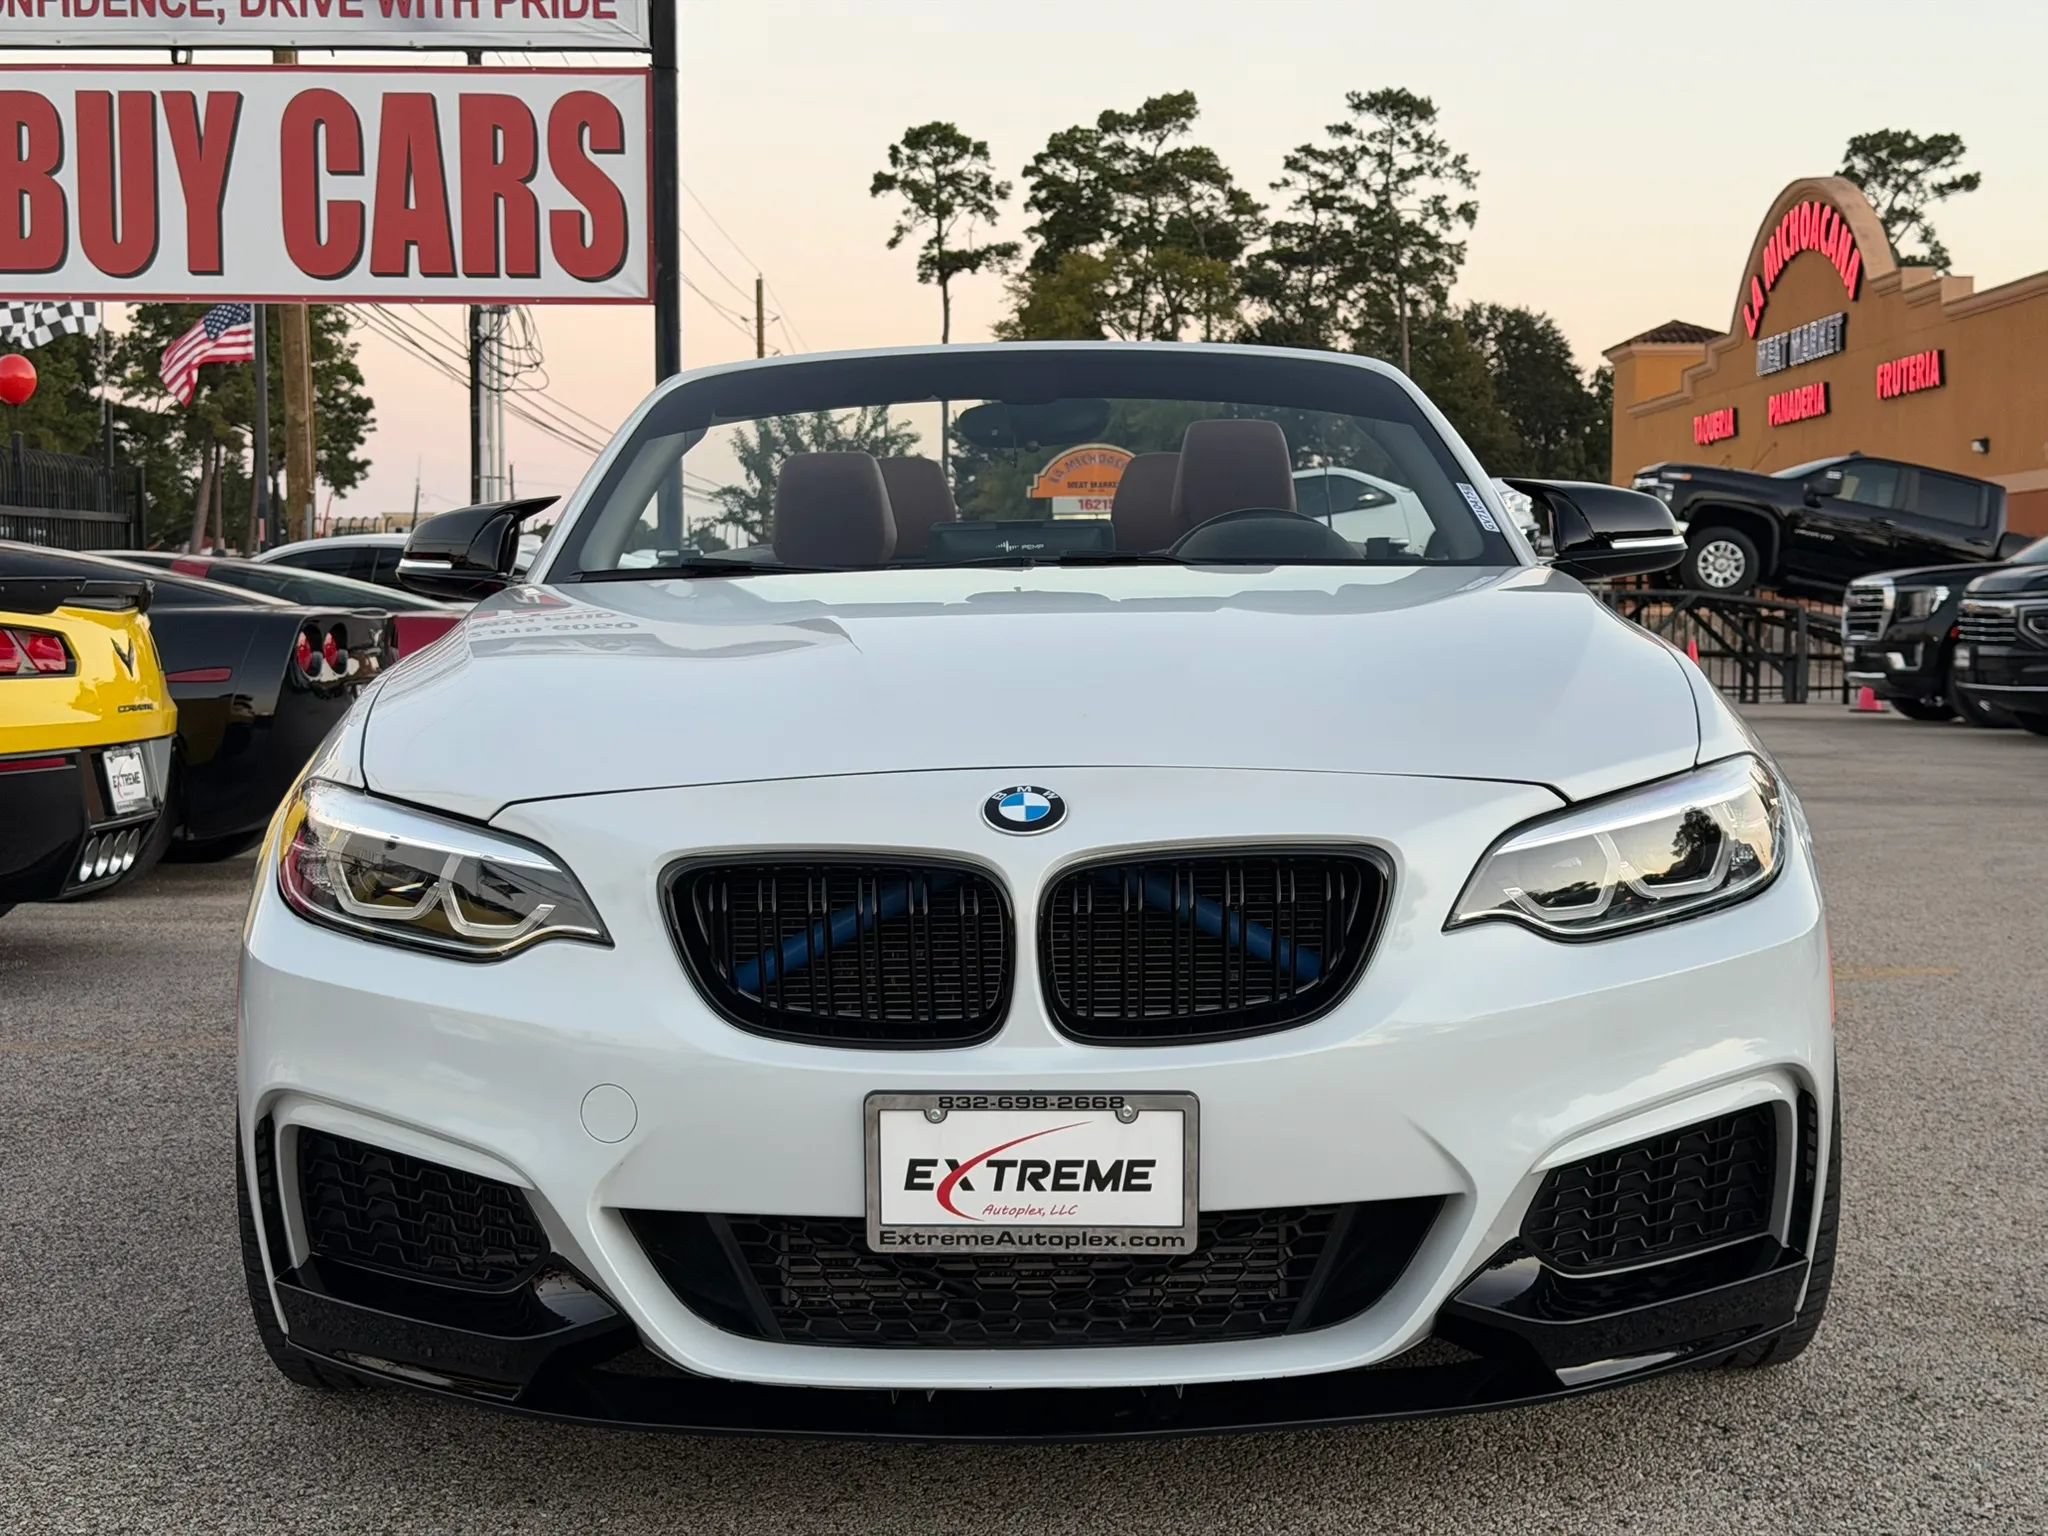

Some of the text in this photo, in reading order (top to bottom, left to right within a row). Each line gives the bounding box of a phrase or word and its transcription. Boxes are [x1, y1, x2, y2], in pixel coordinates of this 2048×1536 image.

[0, 87, 629, 283] BUY CARS
[1743, 200, 1860, 340] LA MICHOACANA
[1790, 312, 1844, 367] MARKET
[1877, 350, 1941, 400] FRUTERIA
[1769, 382, 1827, 427] PANADERIA
[1693, 408, 1735, 445] TAQUERIA
[991, 785, 1059, 800] BMW
[938, 1095, 1125, 1109] 832-698-2668
[904, 1158, 1157, 1192] EXTREME
[982, 1203, 1079, 1218] Autoplex, LLC
[879, 1230, 1186, 1248] ExtremeAutoplex.com
